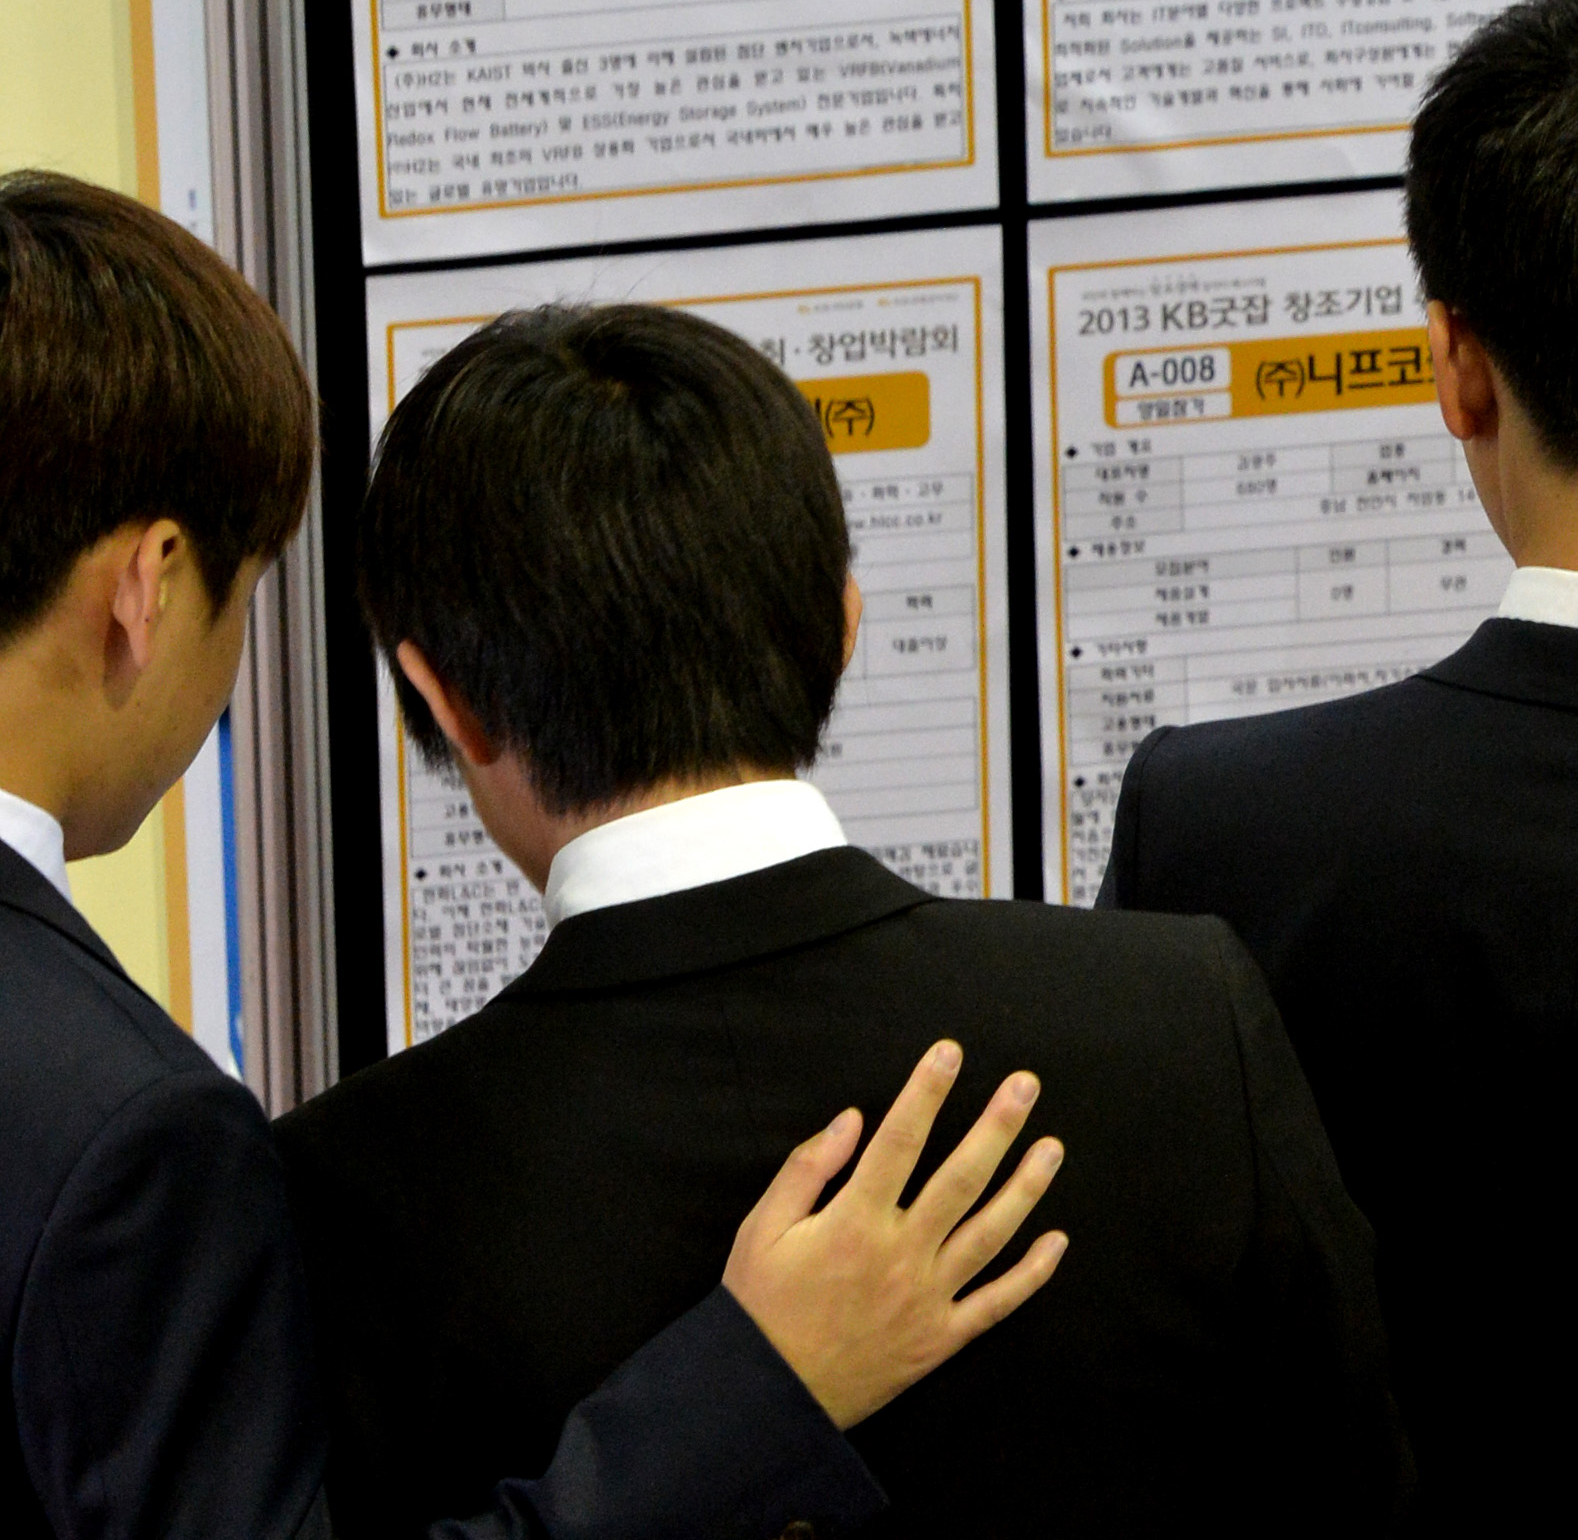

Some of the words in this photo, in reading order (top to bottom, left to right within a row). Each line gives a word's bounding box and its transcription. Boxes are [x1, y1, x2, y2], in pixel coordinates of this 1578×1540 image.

[1078, 306, 1151, 336] 2013
[1161, 297, 1270, 332] KB굿잡
[1284, 283, 1403, 323] 창조기업
[1129, 356, 1216, 388] A-008
[1255, 345, 1439, 399] (주)니프코
[1137, 398, 1205, 420] 양일참가
